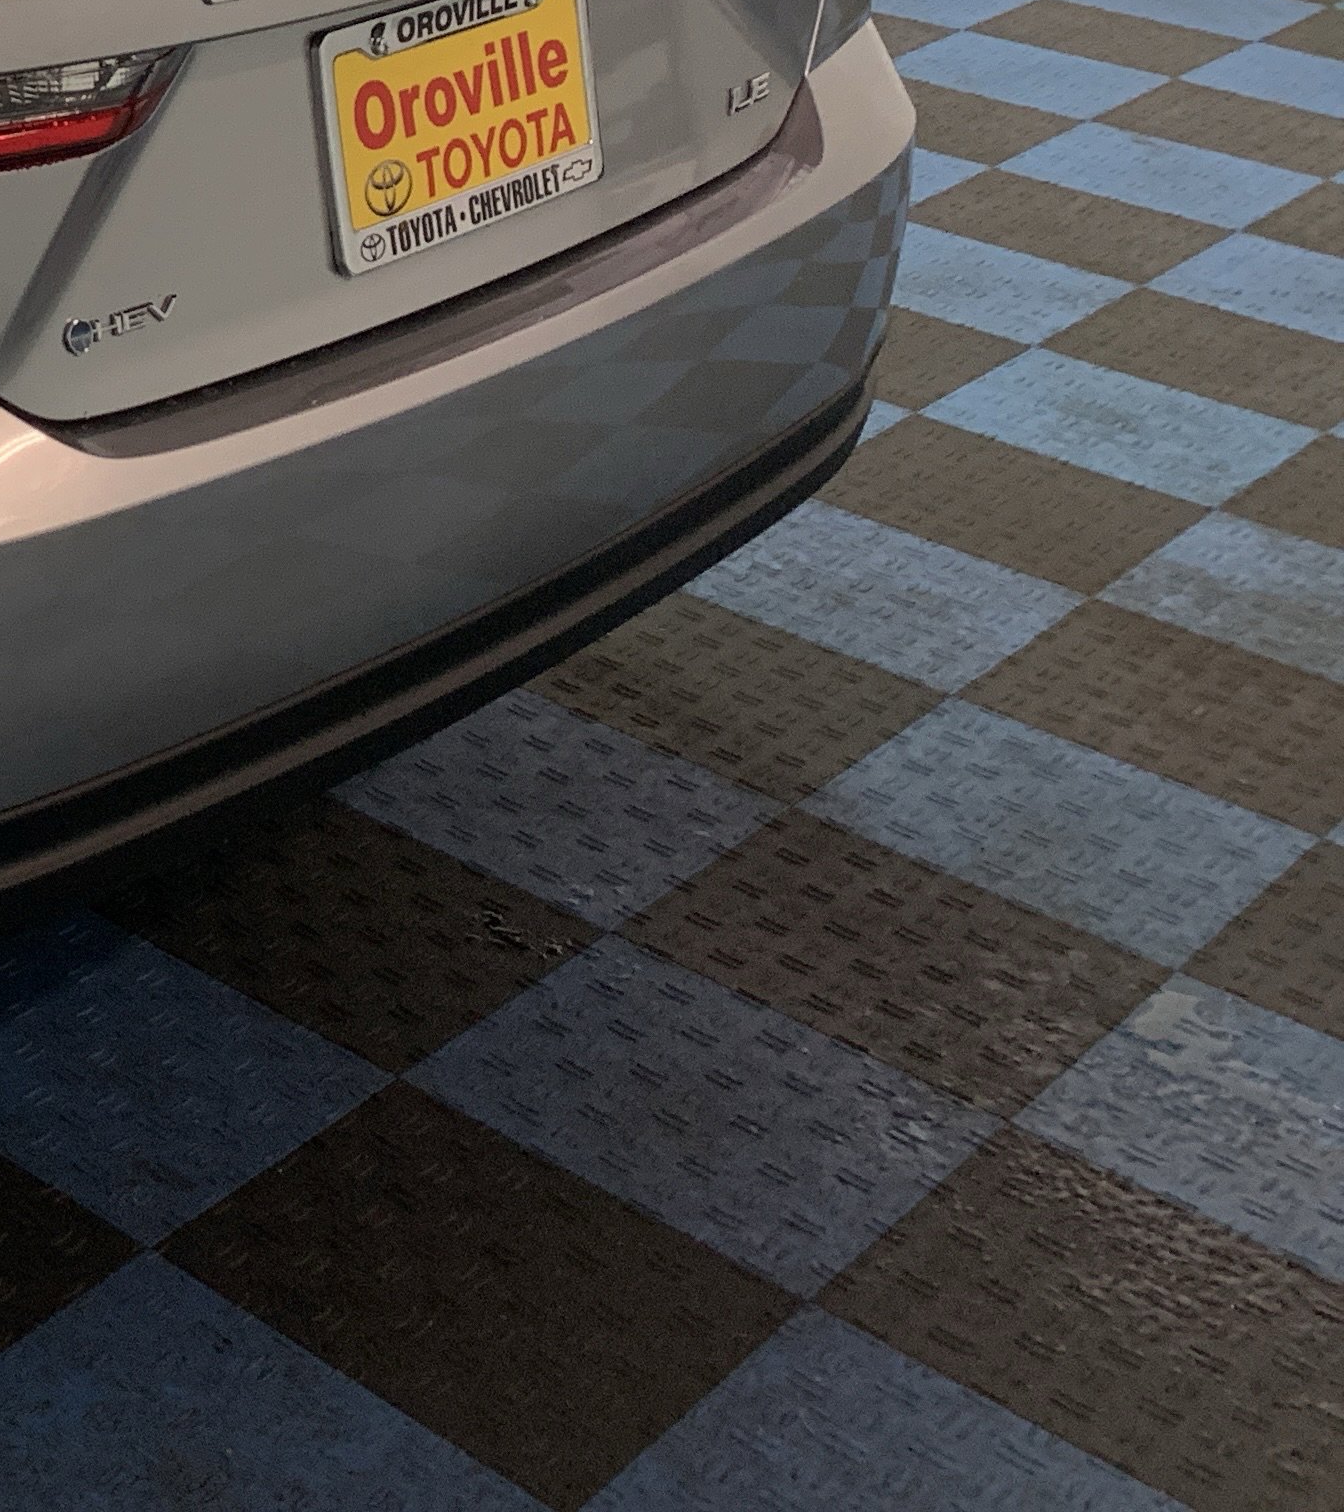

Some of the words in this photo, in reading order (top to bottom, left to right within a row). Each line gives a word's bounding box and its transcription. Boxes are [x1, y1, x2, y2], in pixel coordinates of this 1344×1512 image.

[354, 30, 569, 150] Oroville
[726, 71, 770, 116] LE
[416, 102, 577, 198] TOYOTA
[386, 204, 458, 256] TOYOTA
[469, 164, 561, 225] CHEVROLET
